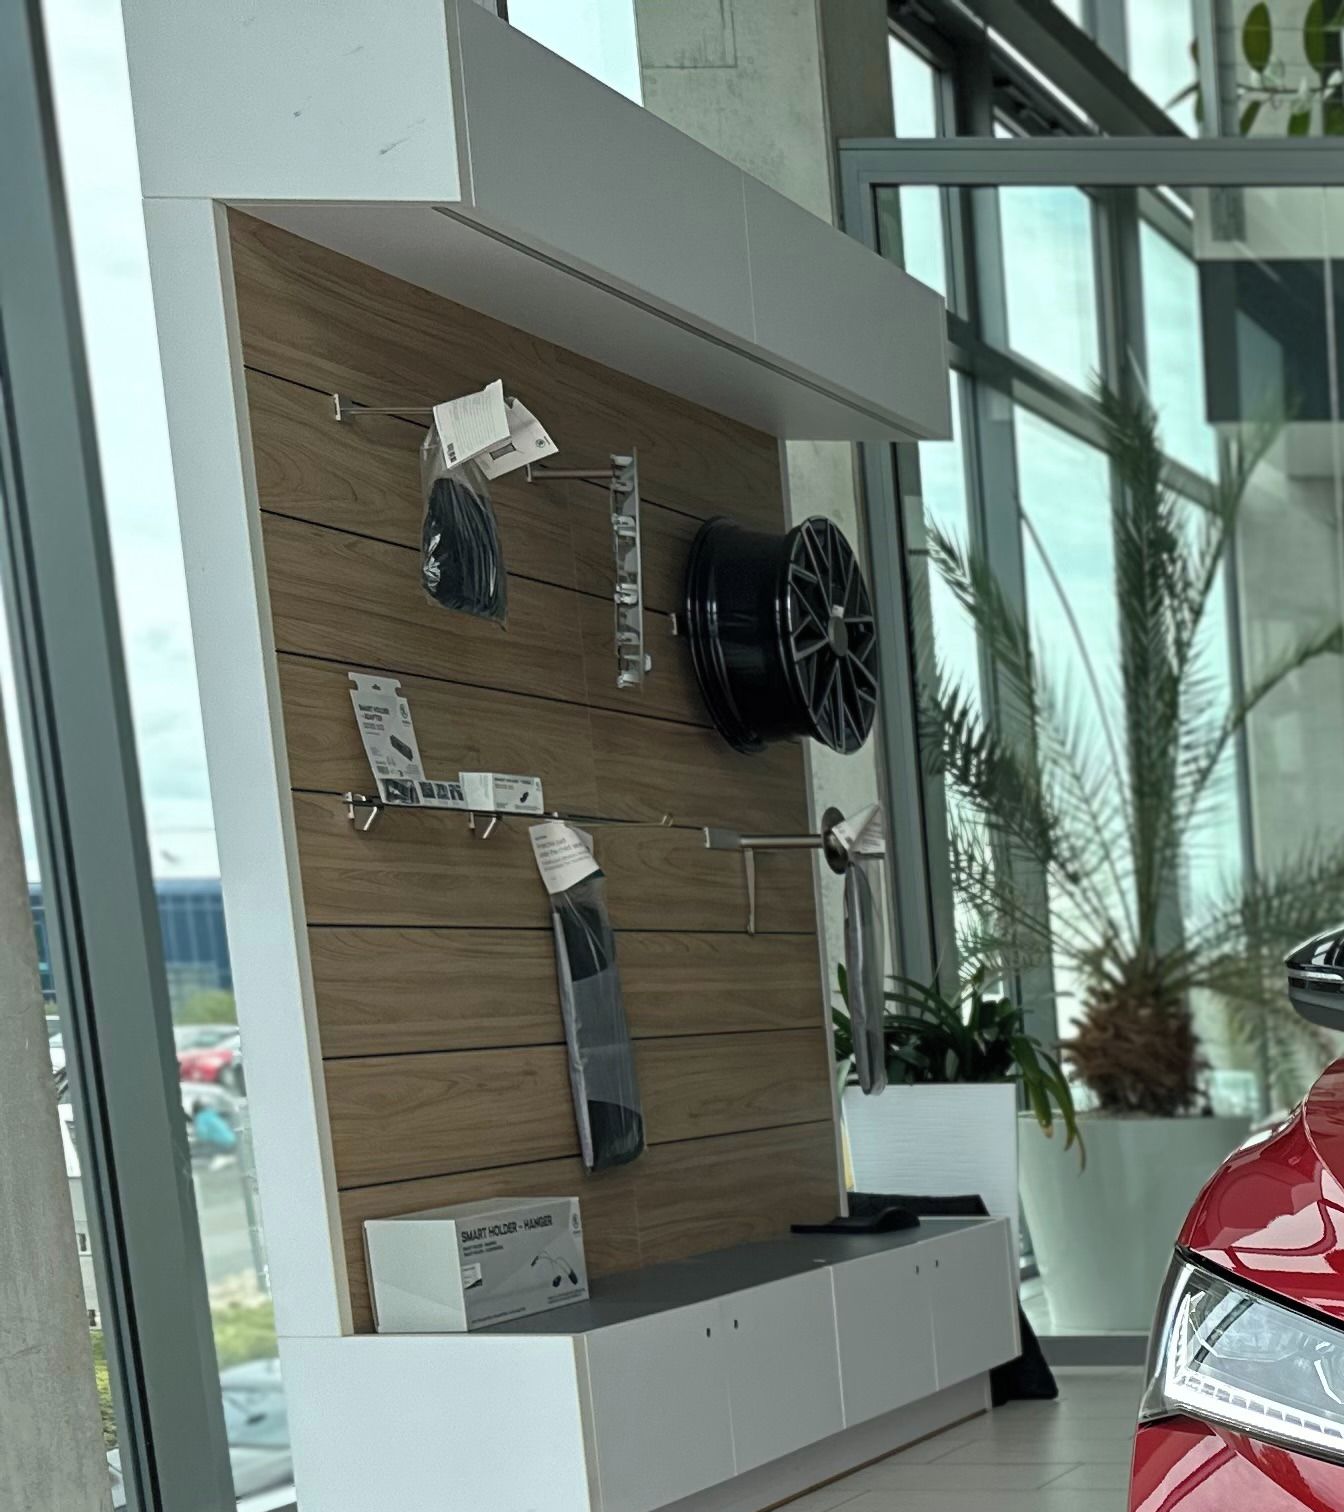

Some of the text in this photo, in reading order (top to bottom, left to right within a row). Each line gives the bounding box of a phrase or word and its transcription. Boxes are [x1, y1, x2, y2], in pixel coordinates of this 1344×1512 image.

[461, 1227, 487, 1243] SMART
[488, 1221, 518, 1238] HOLDER
[523, 1214, 553, 1231] HANGER
